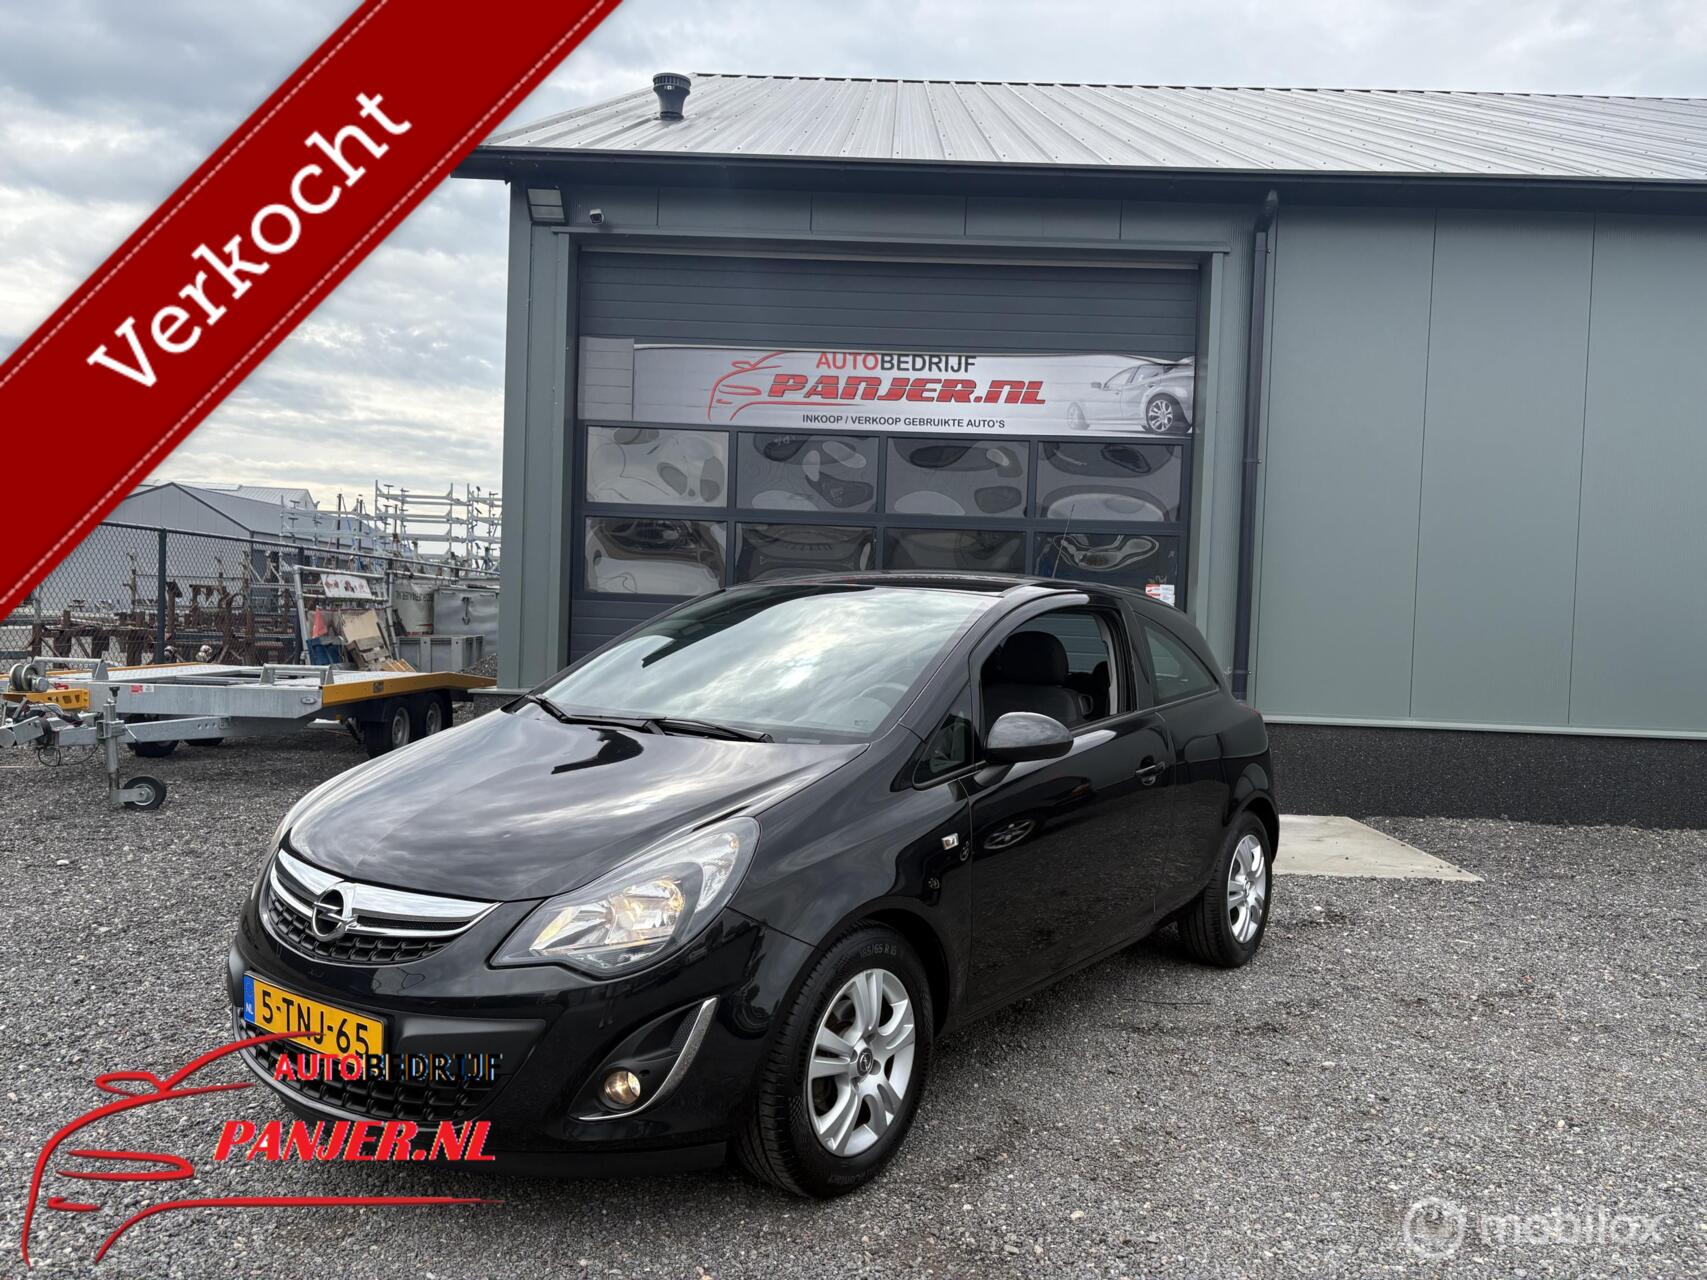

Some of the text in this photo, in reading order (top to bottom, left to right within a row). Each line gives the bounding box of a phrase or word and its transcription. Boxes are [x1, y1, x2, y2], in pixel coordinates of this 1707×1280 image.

[815, 351, 977, 373] AUTOBEDRIJF
[767, 373, 1047, 405] PANJER.NL
[802, 414, 1006, 429] INKOOP / VERKOOP GEBRUIKTE AUTO'S
[245, 1001, 254, 1015] NL
[262, 989, 370, 1056] 5-TNJ-65
